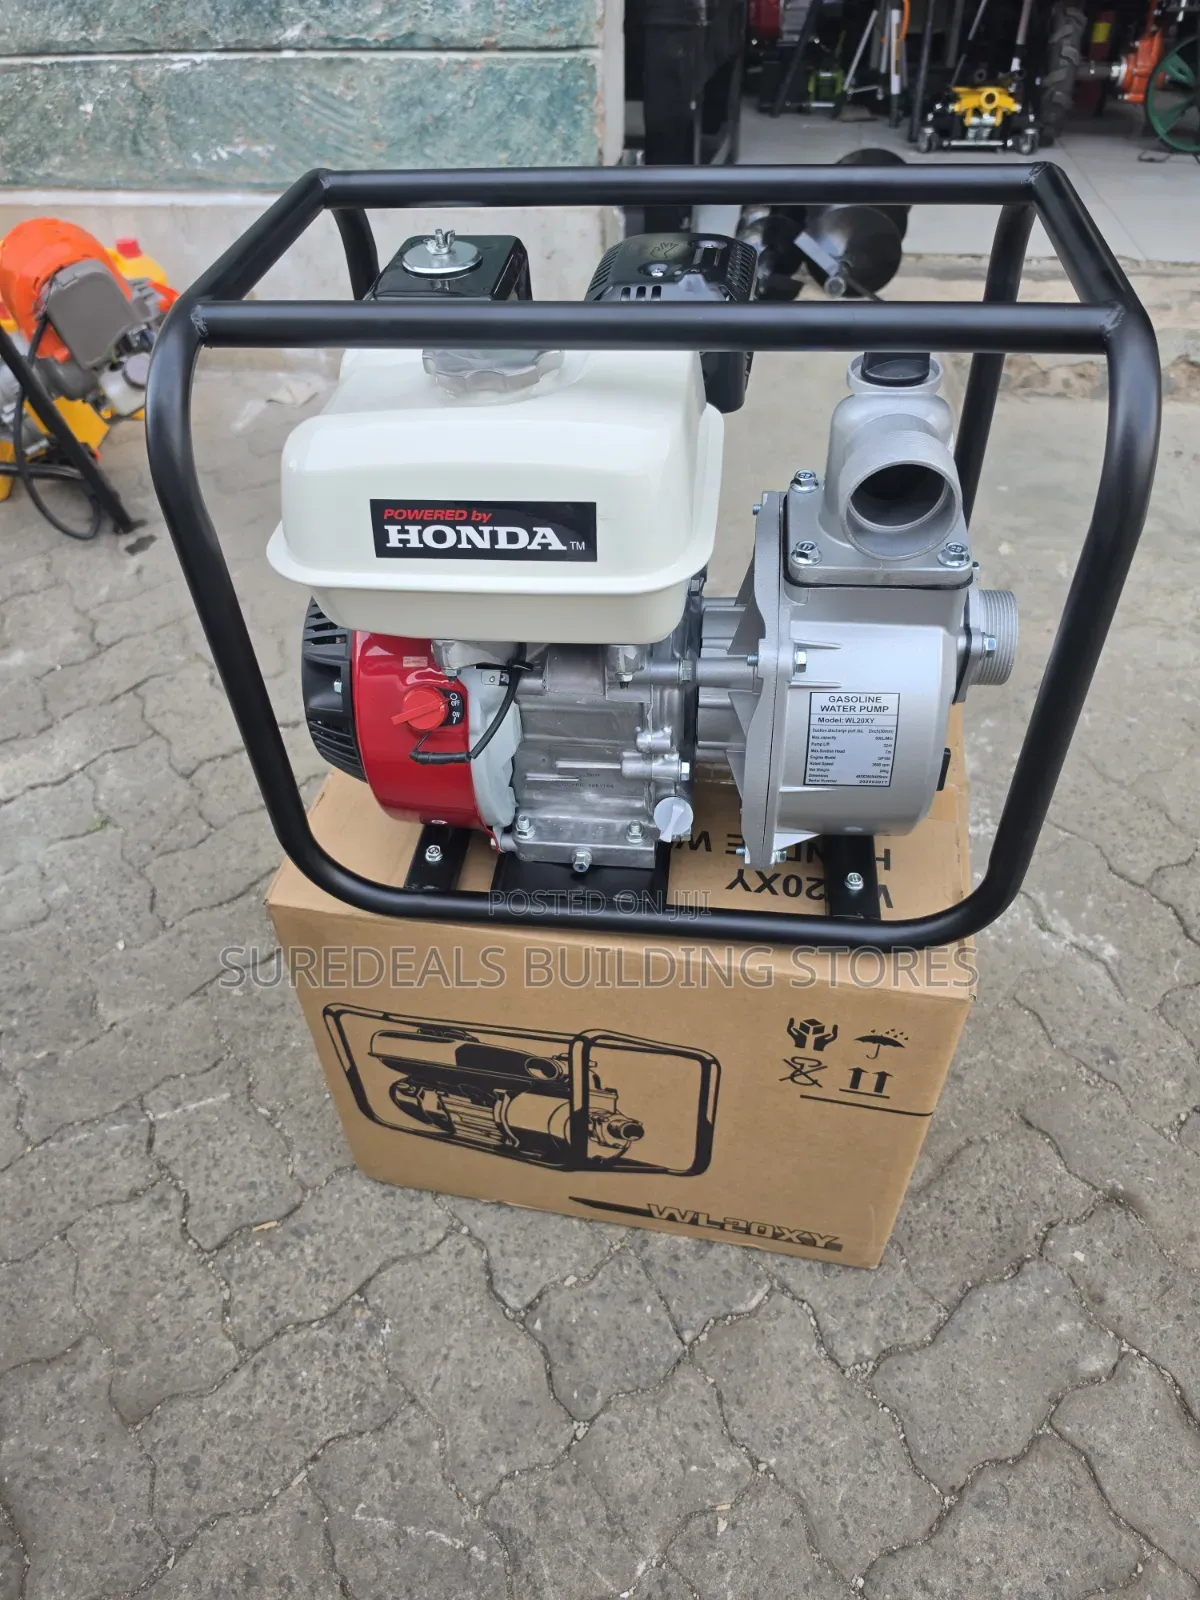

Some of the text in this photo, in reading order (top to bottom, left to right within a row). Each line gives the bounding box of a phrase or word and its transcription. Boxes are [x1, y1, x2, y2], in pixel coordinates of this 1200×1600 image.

[383, 509, 493, 523] POWERED by
[384, 524, 586, 551] HONDA TM
[828, 695, 882, 704] GASOLINE
[820, 705, 889, 714] WATER PUMP
[844, 717, 875, 725] WL20XY
[646, 1203, 841, 1249] WL20XY
